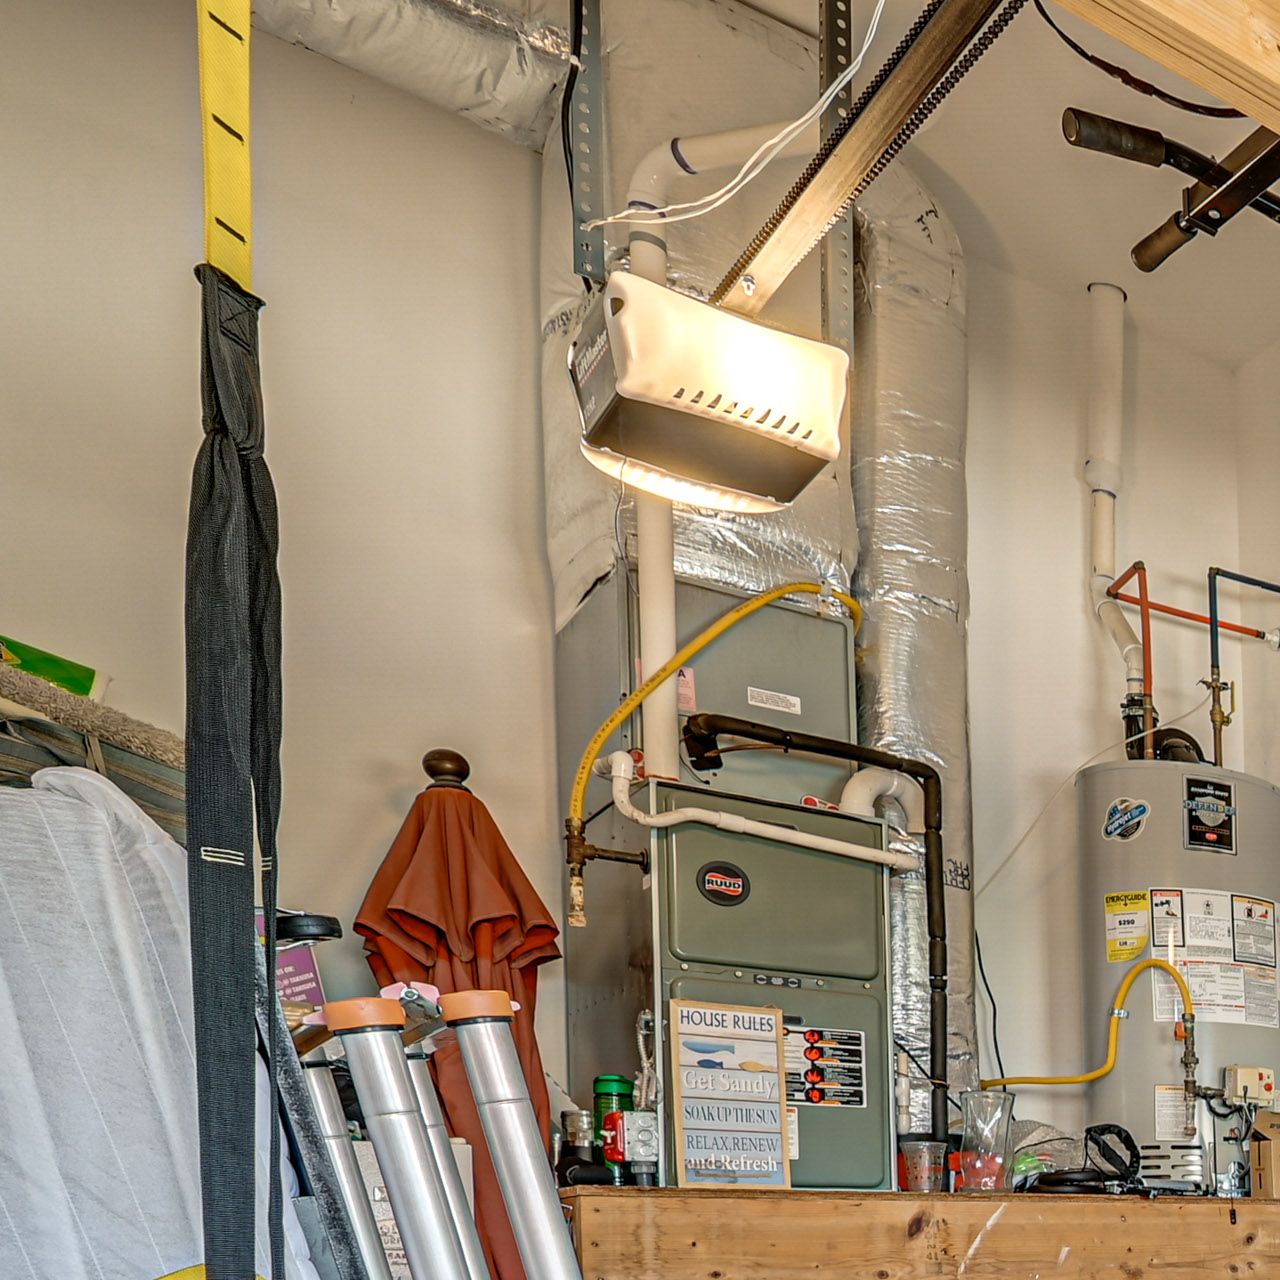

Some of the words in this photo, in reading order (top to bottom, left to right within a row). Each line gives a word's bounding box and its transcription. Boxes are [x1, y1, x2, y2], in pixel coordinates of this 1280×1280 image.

[677, 668, 687, 679] A
[706, 878, 742, 890] RUUD
[680, 1009, 728, 1029] HOUSE
[733, 1014, 774, 1033] RULES
[685, 1070, 717, 1091] Get
[718, 1073, 776, 1099] Sandy
[684, 1104, 716, 1122] SOAK
[716, 1106, 732, 1122] UP
[732, 1107, 755, 1124] THE
[755, 1108, 778, 1125] SUN
[686, 1154, 717, 1171] and
[720, 1154, 778, 1173] Refresh
